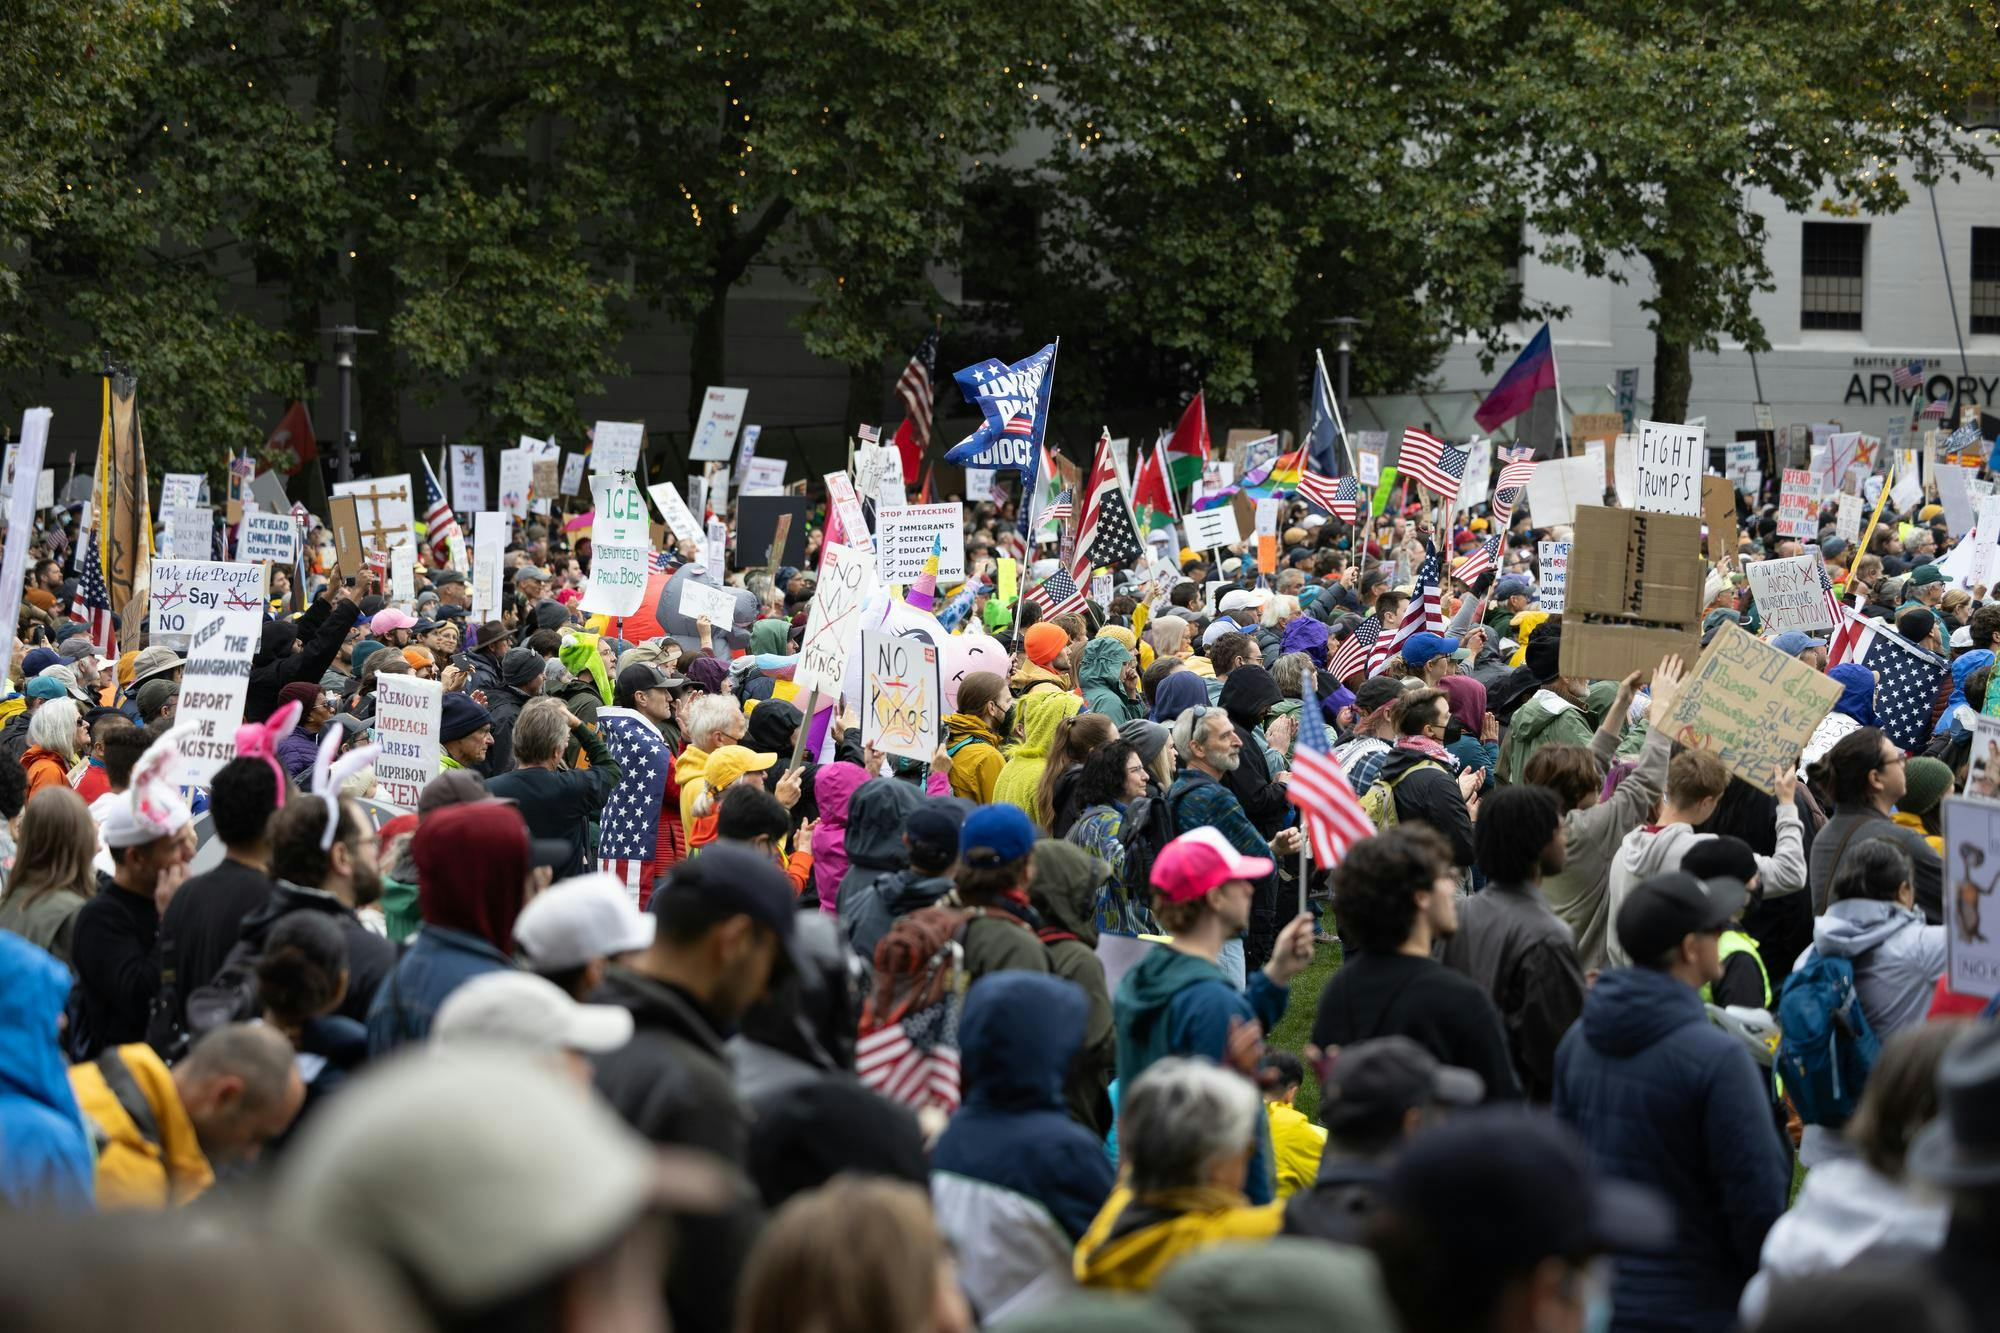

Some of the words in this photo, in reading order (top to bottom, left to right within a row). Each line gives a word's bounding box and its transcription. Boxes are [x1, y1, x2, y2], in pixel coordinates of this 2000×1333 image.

[1853, 357, 1896, 367] SEATTLE
[1638, 466, 1691, 501] TRUMP'S
[1783, 470, 1812, 486] DEFEND
[606, 488, 639, 520] ICE
[1780, 494, 1809, 508] DEFUND
[906, 507, 957, 517] ATTACKING!
[899, 523, 955, 532] IMMIGRANTS
[899, 535, 935, 543] SCIENCE
[597, 545, 639, 561] DEPUTIZED
[1542, 544, 1549, 554] IF
[156, 565, 180, 580] We
[187, 566, 209, 581] the
[211, 567, 259, 587] People
[620, 567, 643, 588] BOYS
[831, 562, 862, 589] NO
[1544, 572, 1553, 582] TO
[1768, 574, 1799, 593] ANGRY
[189, 587, 219, 609] Say
[1541, 587, 1556, 595] WOULD
[160, 614, 184, 631] NO
[1777, 602, 1828, 626] ATTENTION!
[193, 616, 225, 648] KEEP
[225, 635, 248, 652] THE
[184, 659, 251, 678] IMMIGRANTS
[804, 649, 844, 682] KINGS
[879, 643, 908, 678] NO
[183, 692, 233, 711] DEPORT
[193, 719, 216, 737] HE
[177, 741, 235, 762] ACISTS!!
[1962, 959, 1987, 976] NO
